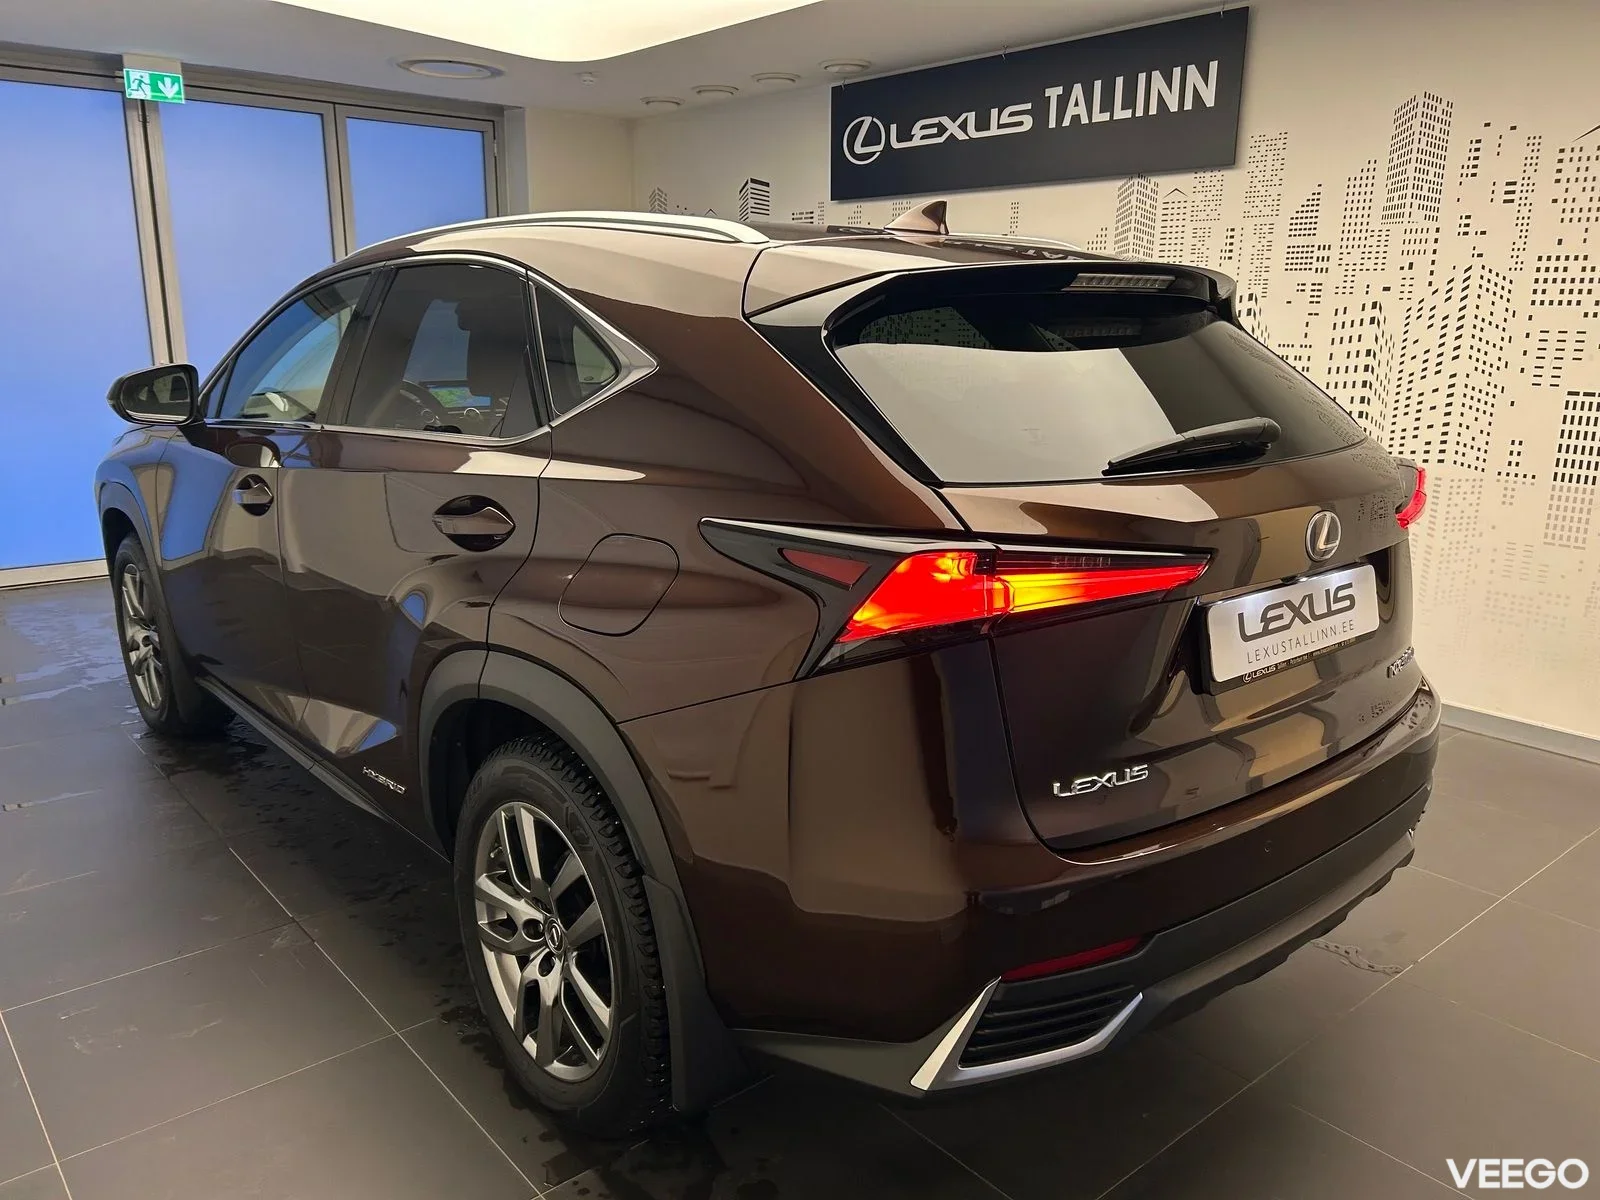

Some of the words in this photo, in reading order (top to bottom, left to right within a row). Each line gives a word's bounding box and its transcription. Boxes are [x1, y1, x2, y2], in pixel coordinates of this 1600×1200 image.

[889, 102, 1033, 149] LEXUS
[1044, 60, 1219, 129] TALLINN
[1238, 582, 1356, 643] LEXUS
[1247, 619, 1355, 664] LEXUSTALLINN.EE
[1252, 664, 1276, 679] LEXUS
[362, 766, 405, 795] HYBRID
[1053, 764, 1148, 797] LEXUS
